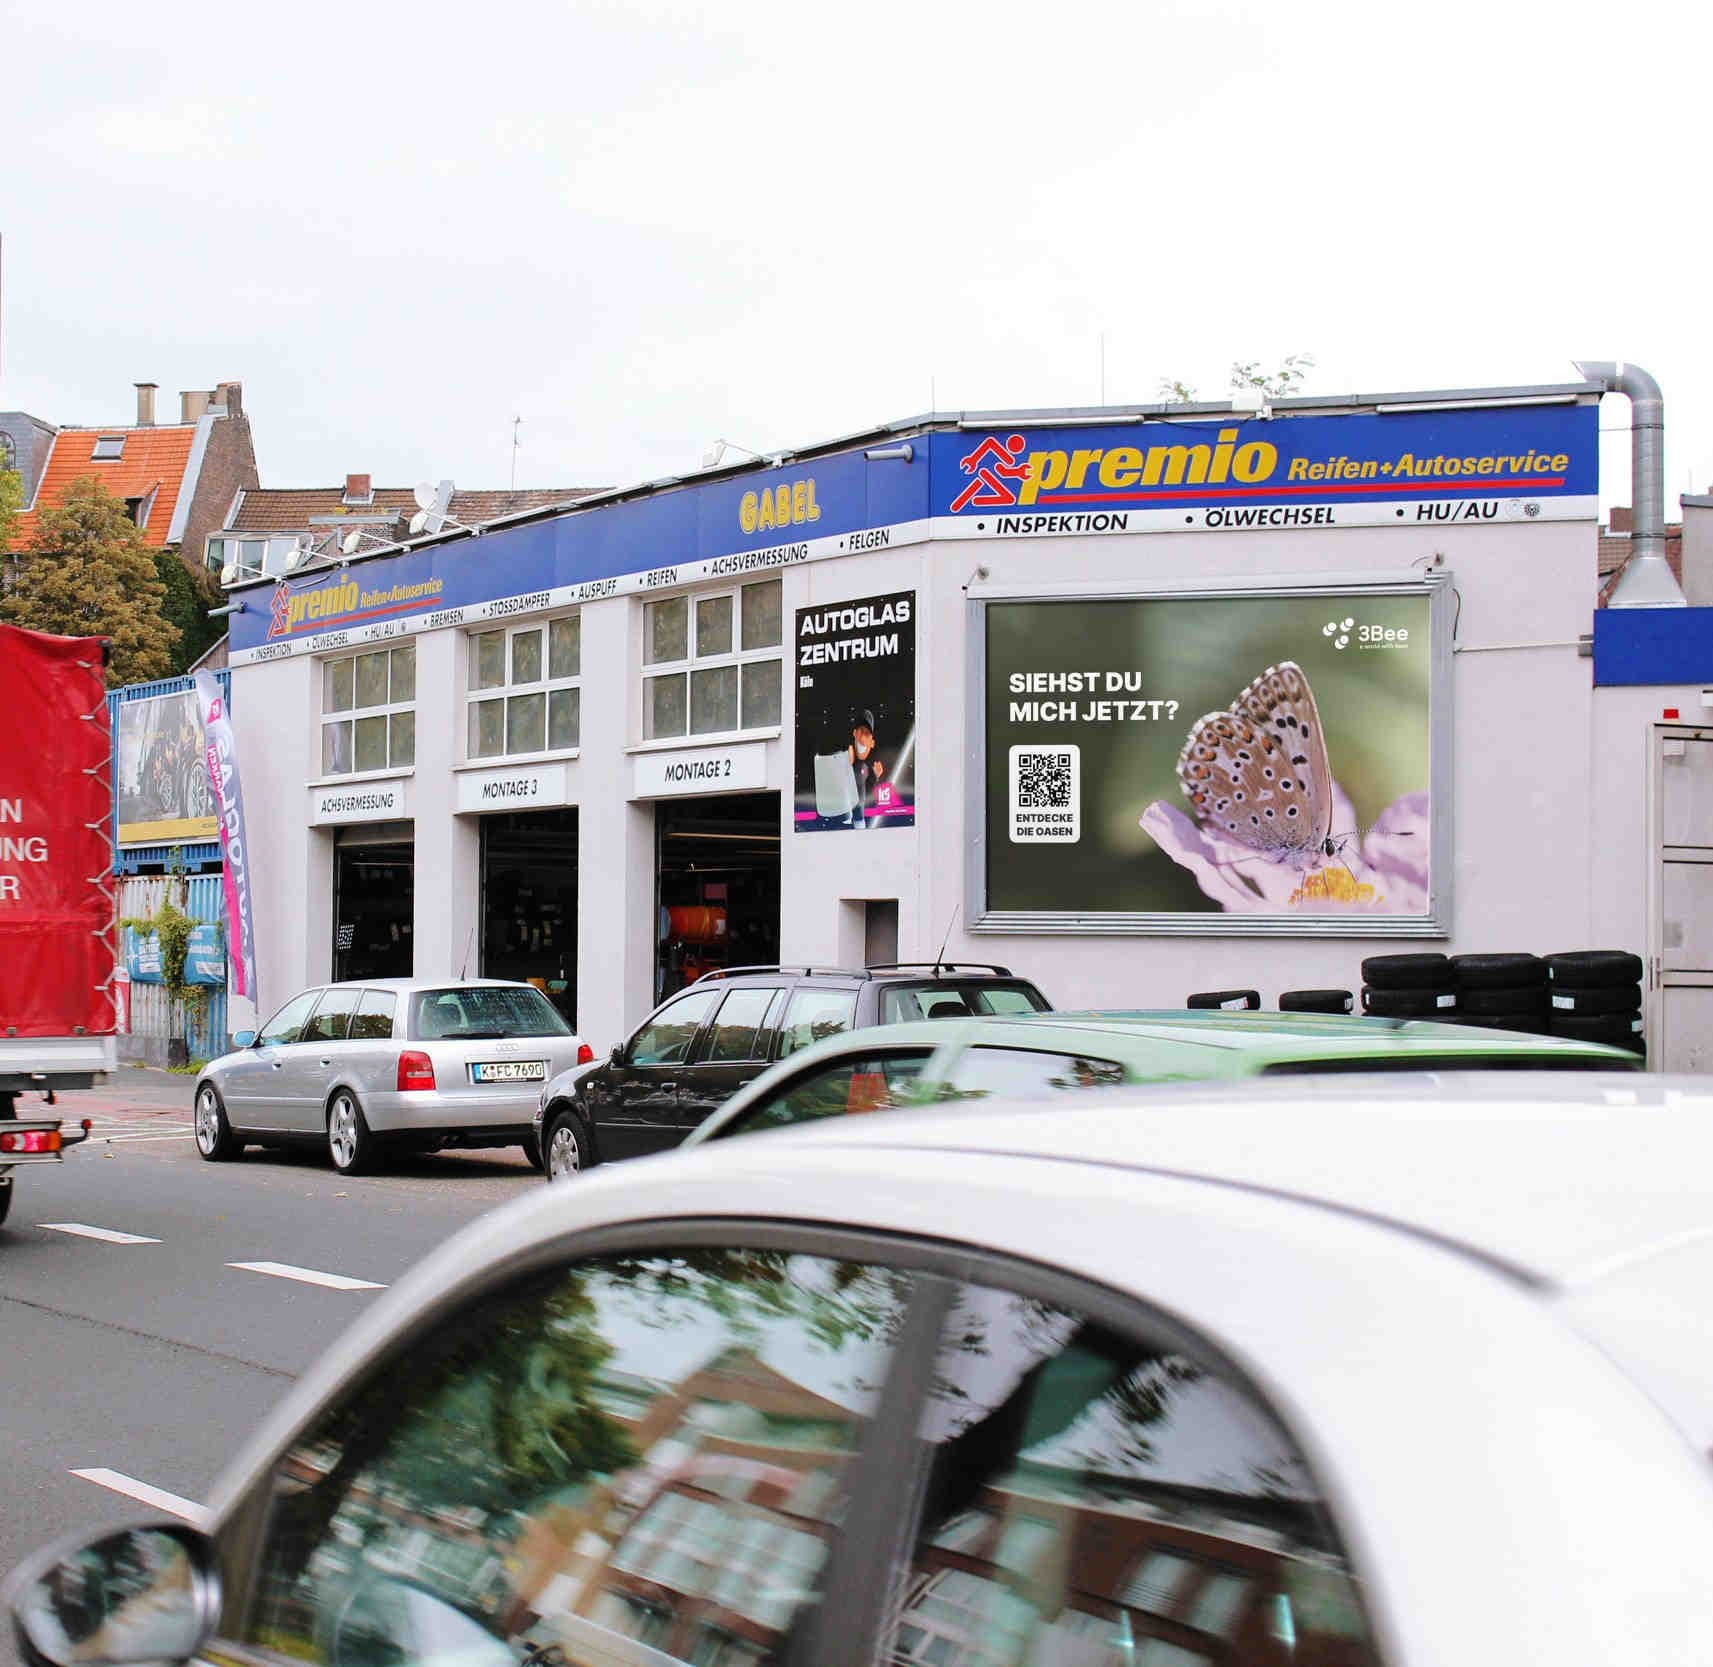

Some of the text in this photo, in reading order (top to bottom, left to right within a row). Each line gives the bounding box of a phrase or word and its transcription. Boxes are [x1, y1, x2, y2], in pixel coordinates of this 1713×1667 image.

[1017, 428, 1278, 505] premio
[1287, 449, 1569, 481] Reifen+Autoservice
[740, 480, 820, 533] GABEL
[1205, 506, 1336, 529] ÖLWECHSEL
[1417, 501, 1498, 522] HU/AU
[996, 513, 1128, 534] INSPEKTION
[849, 529, 889, 551] FELGEN
[711, 544, 808, 576] ACHSVERMESSUNG
[647, 568, 677, 587] REIFEN
[579, 579, 617, 600] AUSPUFF
[286, 574, 359, 633] premio
[430, 609, 464, 626] BREMSEN
[800, 601, 910, 636] AUTOGLAS
[1358, 625, 1408, 642] 3Bee
[256, 644, 292, 660] INSPEKTION
[800, 633, 898, 666] ZENTRUM
[1009, 671, 1142, 693] SIEHST DU
[1009, 700, 1179, 722] MICH JETZT?
[665, 759, 731, 782] MONTAGE 2
[482, 779, 538, 799] MONTAGE 3
[321, 793, 394, 813] ACHSVERMESSUNG
[1016, 813, 1074, 823] ENTDECKE
[1016, 827, 1073, 836] DIE OASEN
[0, 837, 48, 862] NG
